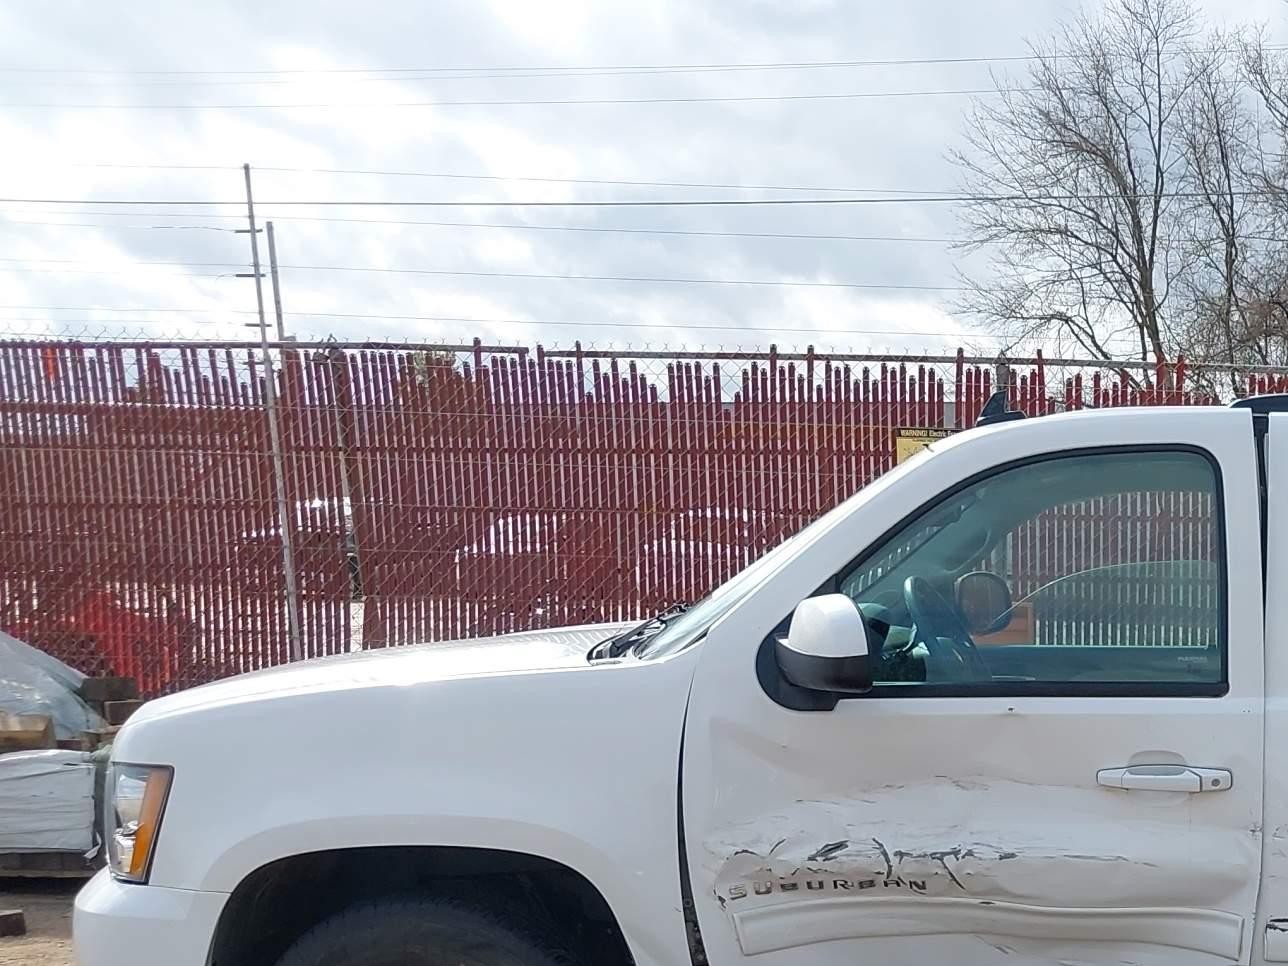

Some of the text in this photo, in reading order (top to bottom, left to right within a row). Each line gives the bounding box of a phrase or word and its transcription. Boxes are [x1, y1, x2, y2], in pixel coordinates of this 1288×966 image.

[900, 429, 928, 437] WARNING!
[929, 430, 946, 438] Electric
[729, 879, 927, 900] SUBURBAN
